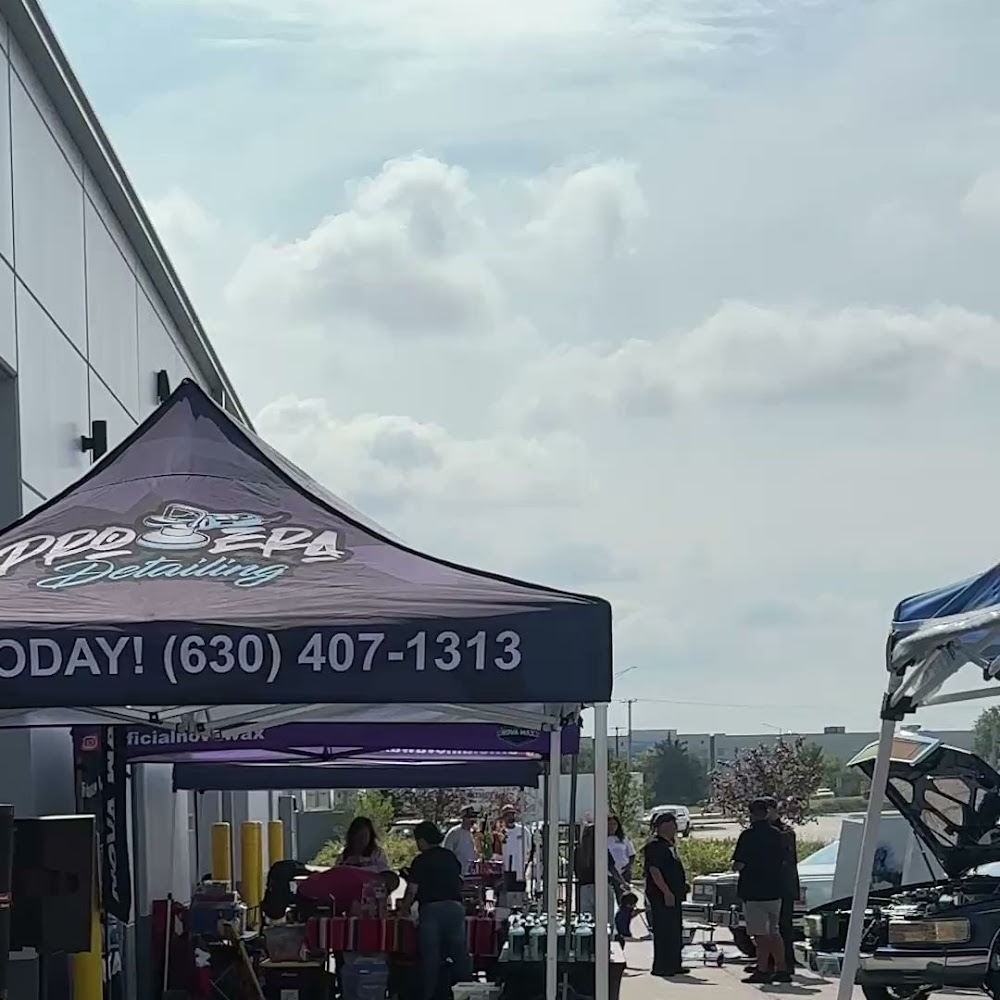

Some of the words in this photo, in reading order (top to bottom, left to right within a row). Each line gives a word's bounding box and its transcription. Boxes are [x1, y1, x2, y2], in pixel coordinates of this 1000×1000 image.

[208, 526, 346, 563] ERA
[36, 555, 290, 590] Detailing
[163, 632, 282, 684] (630)
[297, 630, 522, 672] 407-1313
